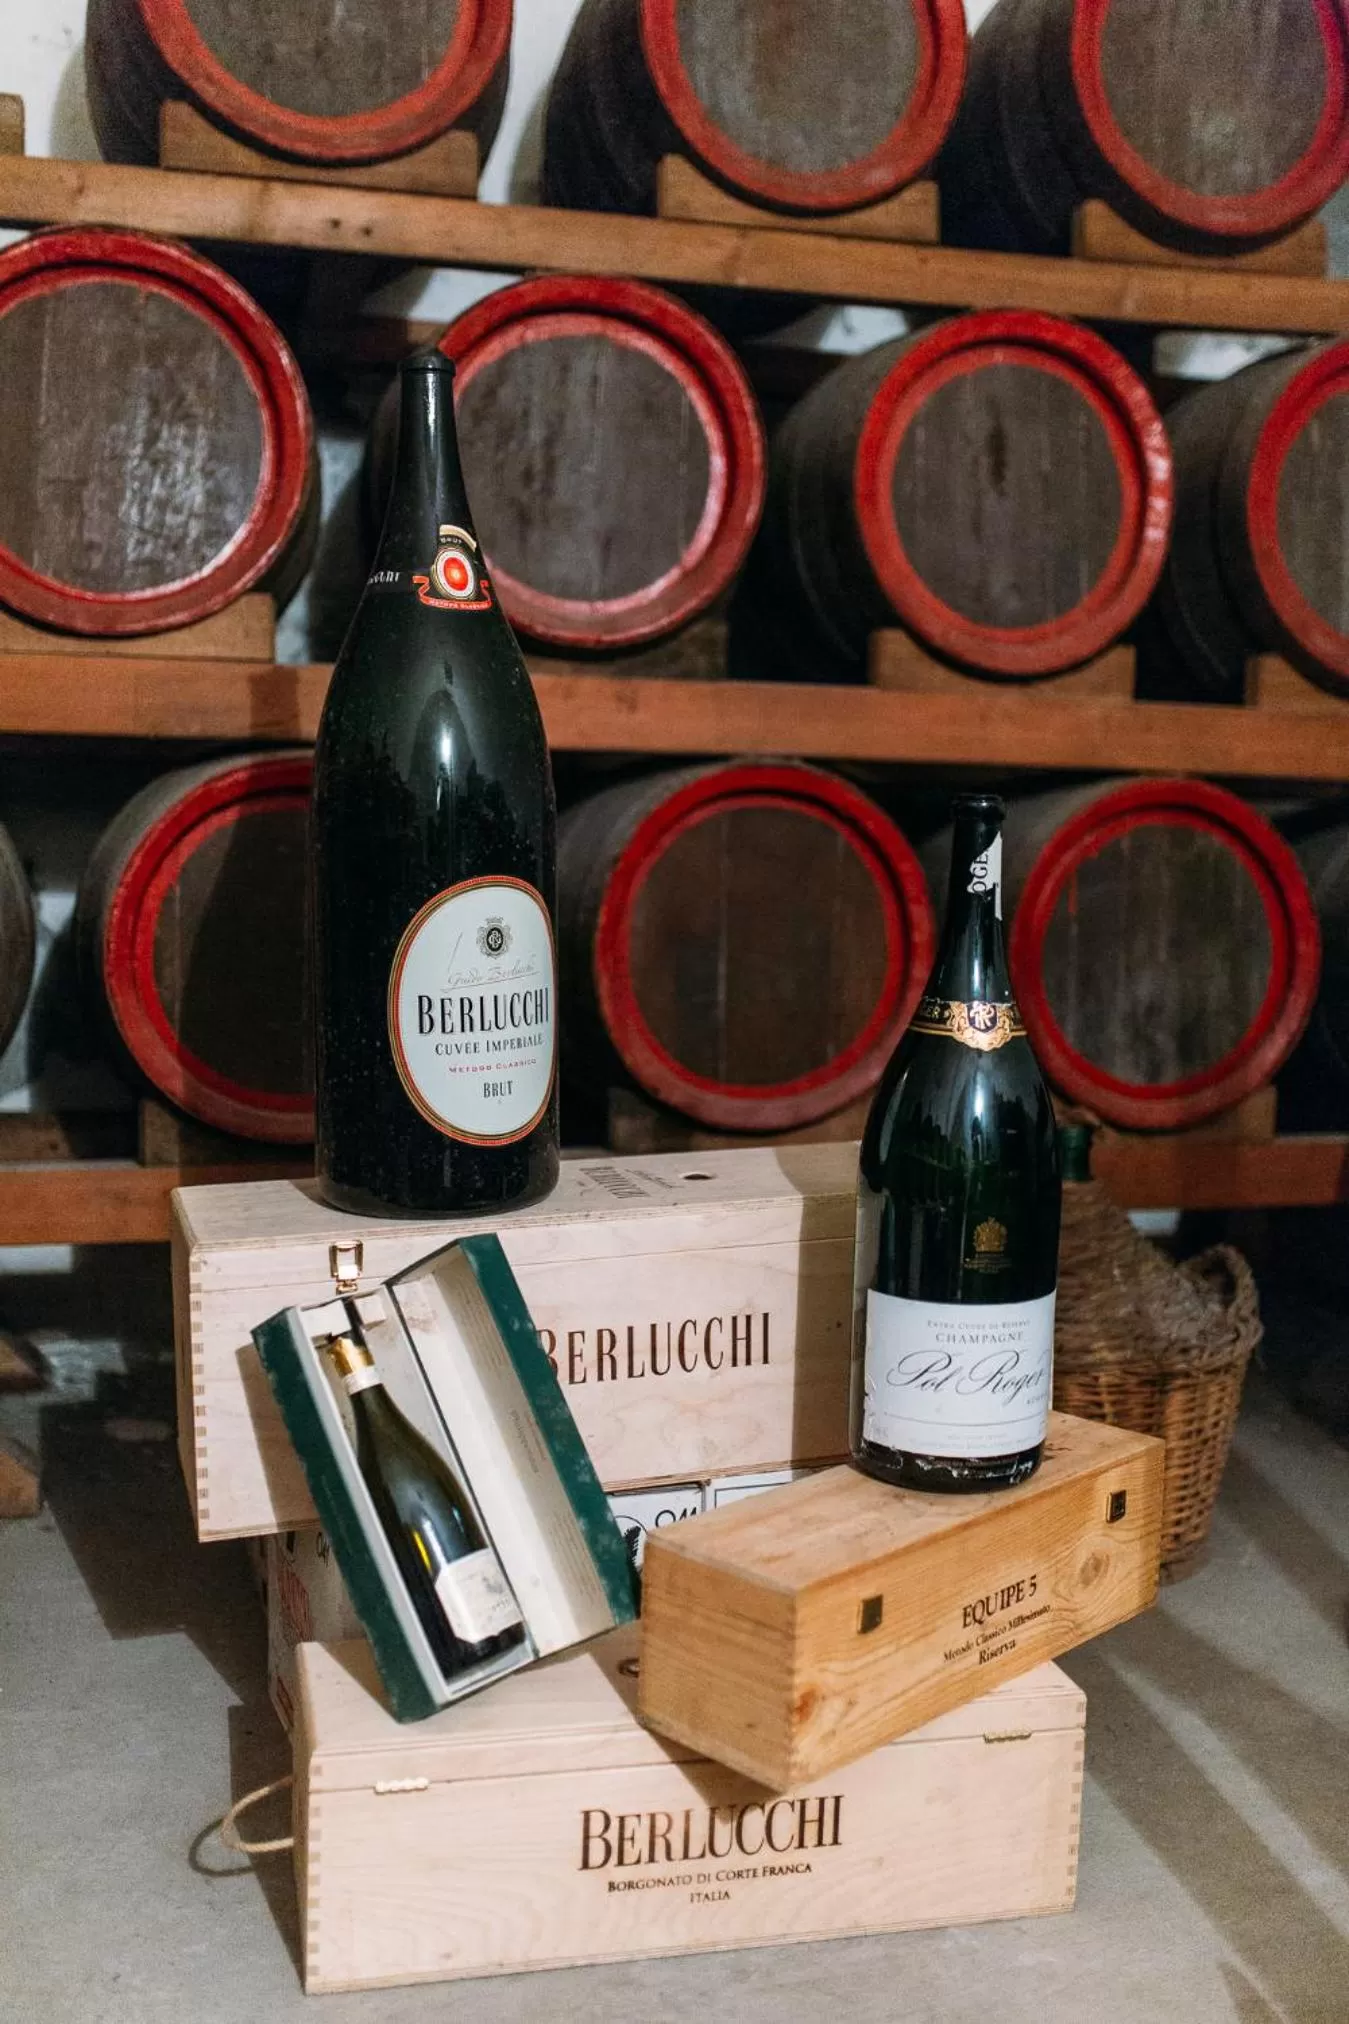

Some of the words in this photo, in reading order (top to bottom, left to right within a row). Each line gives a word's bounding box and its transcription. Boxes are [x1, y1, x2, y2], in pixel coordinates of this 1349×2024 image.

[417, 987, 549, 1035] BERLUCCHI
[486, 1034, 543, 1053] IMPERIALE
[483, 1081, 513, 1099] BRUT
[935, 1331, 1024, 1345] CHAMPAGNE
[886, 1350, 964, 1393] Pol
[955, 1349, 1049, 1407] Roger
[962, 1579, 1025, 1629] EQUIPE
[1028, 1573, 1038, 1598] 5
[975, 1624, 1007, 1648] Classico
[978, 1639, 1016, 1666] Riserva
[577, 1794, 845, 1872] BERLUCCHI
[607, 1873, 692, 1893] BORGONATO
[696, 1871, 712, 1883] DI
[715, 1866, 758, 1883] CORTE
[761, 1862, 812, 1879] FRANCA
[690, 1889, 731, 1904] ITALIA
